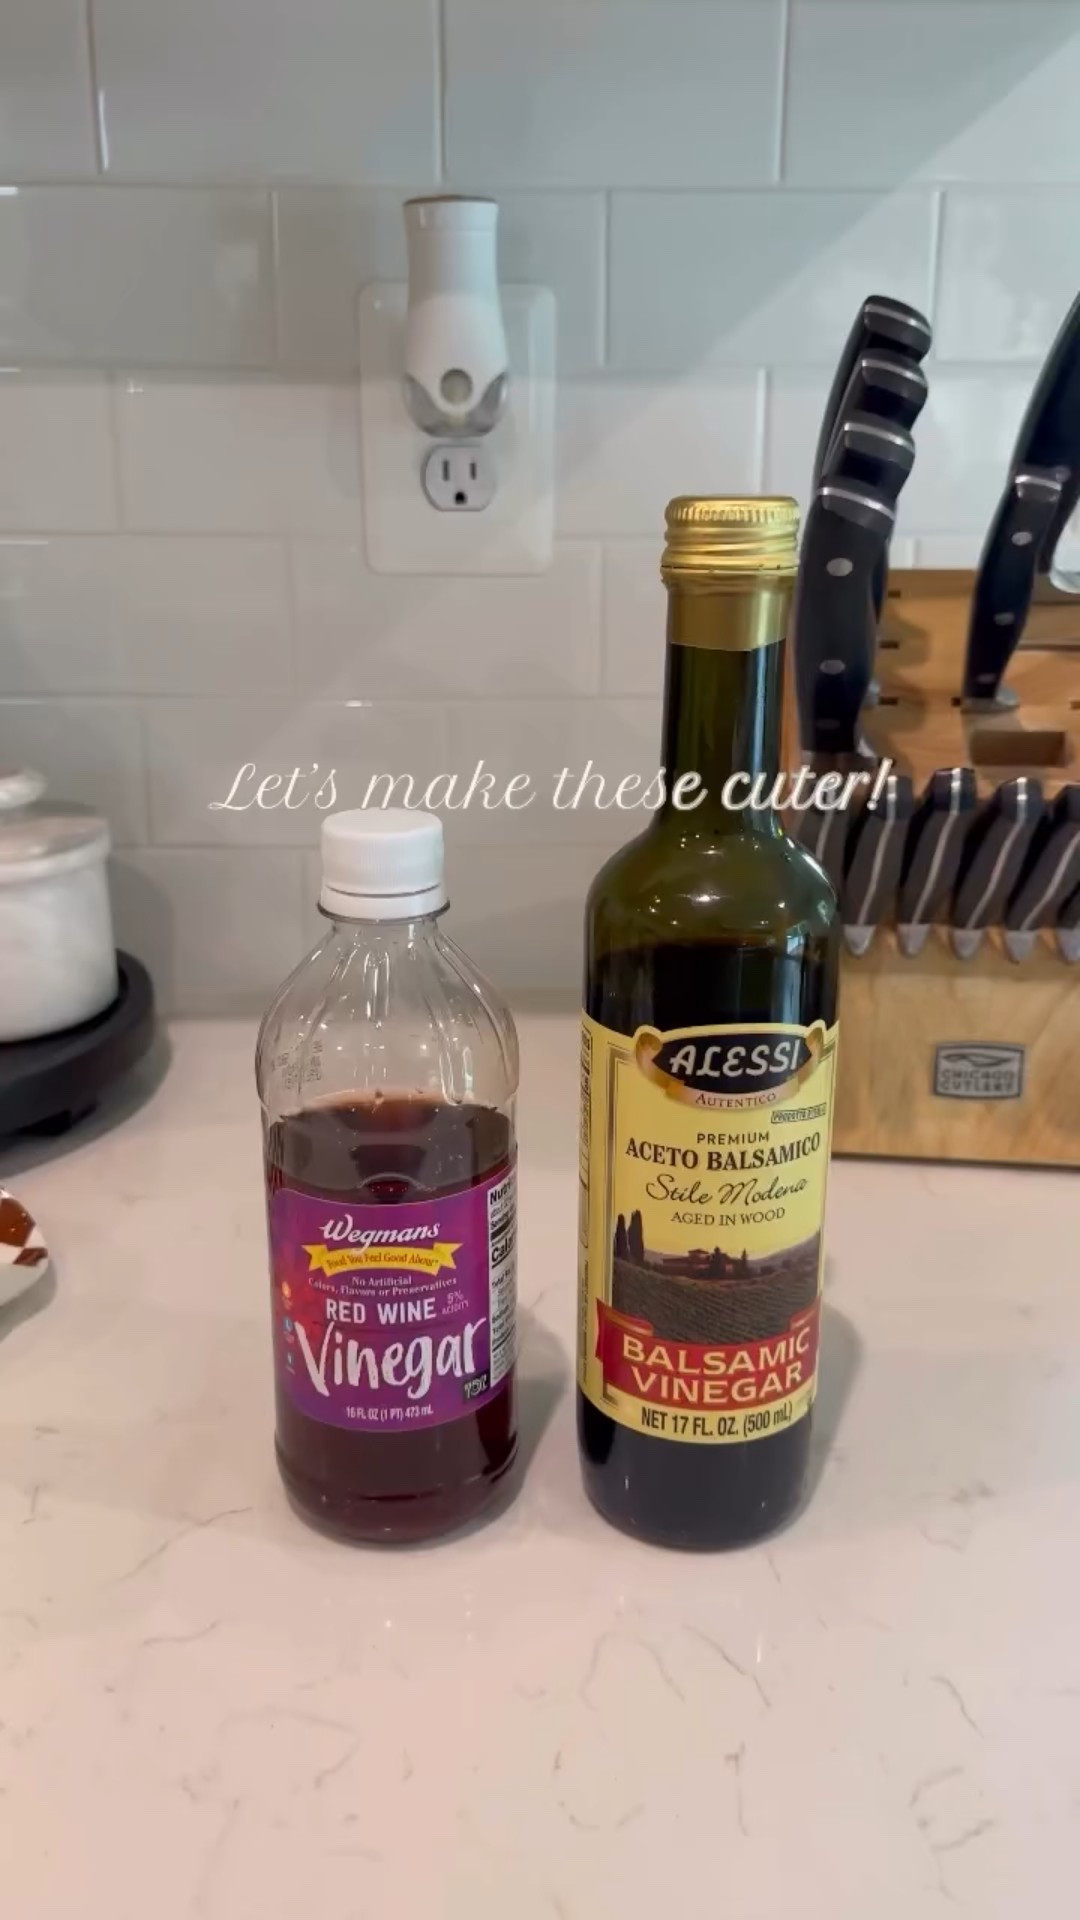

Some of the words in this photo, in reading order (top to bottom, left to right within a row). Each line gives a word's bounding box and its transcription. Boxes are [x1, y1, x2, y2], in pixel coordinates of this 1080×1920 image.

[669, 1039, 801, 1078] ALESSI
[941, 1069, 1015, 1081] CHICAGO
[625, 1137, 698, 1169] ACETO
[707, 1132, 821, 1171] BALSAMICO
[697, 1131, 770, 1145] PREMIUM
[645, 1173, 713, 1205] Stile
[717, 1176, 808, 1206] Modena
[670, 1211, 715, 1226] AGED
[719, 1213, 736, 1226] IN
[739, 1207, 786, 1224] WOOD
[318, 1213, 440, 1254] Wegmans
[364, 1252, 382, 1263] Feel
[383, 1252, 408, 1263] Good
[341, 1285, 376, 1297] Flavors
[379, 1288, 391, 1297] or
[392, 1278, 457, 1297] Preservatives
[351, 1276, 366, 1286] No
[368, 1276, 412, 1287] Artificial
[326, 1299, 366, 1324] RED
[377, 1297, 436, 1325] WINE
[294, 1317, 486, 1399] Vinegar
[623, 1327, 811, 1376] BALSAMIC
[631, 1361, 802, 1404] VINEGAR
[346, 1406, 356, 1418] 16
[368, 1408, 379, 1420] OZ
[405, 1406, 420, 1418] 473
[641, 1406, 668, 1430] NET
[672, 1415, 689, 1434] 17
[692, 1416, 713, 1436] FL.
[717, 1416, 739, 1436] OZ.
[743, 1411, 771, 1437] (500
